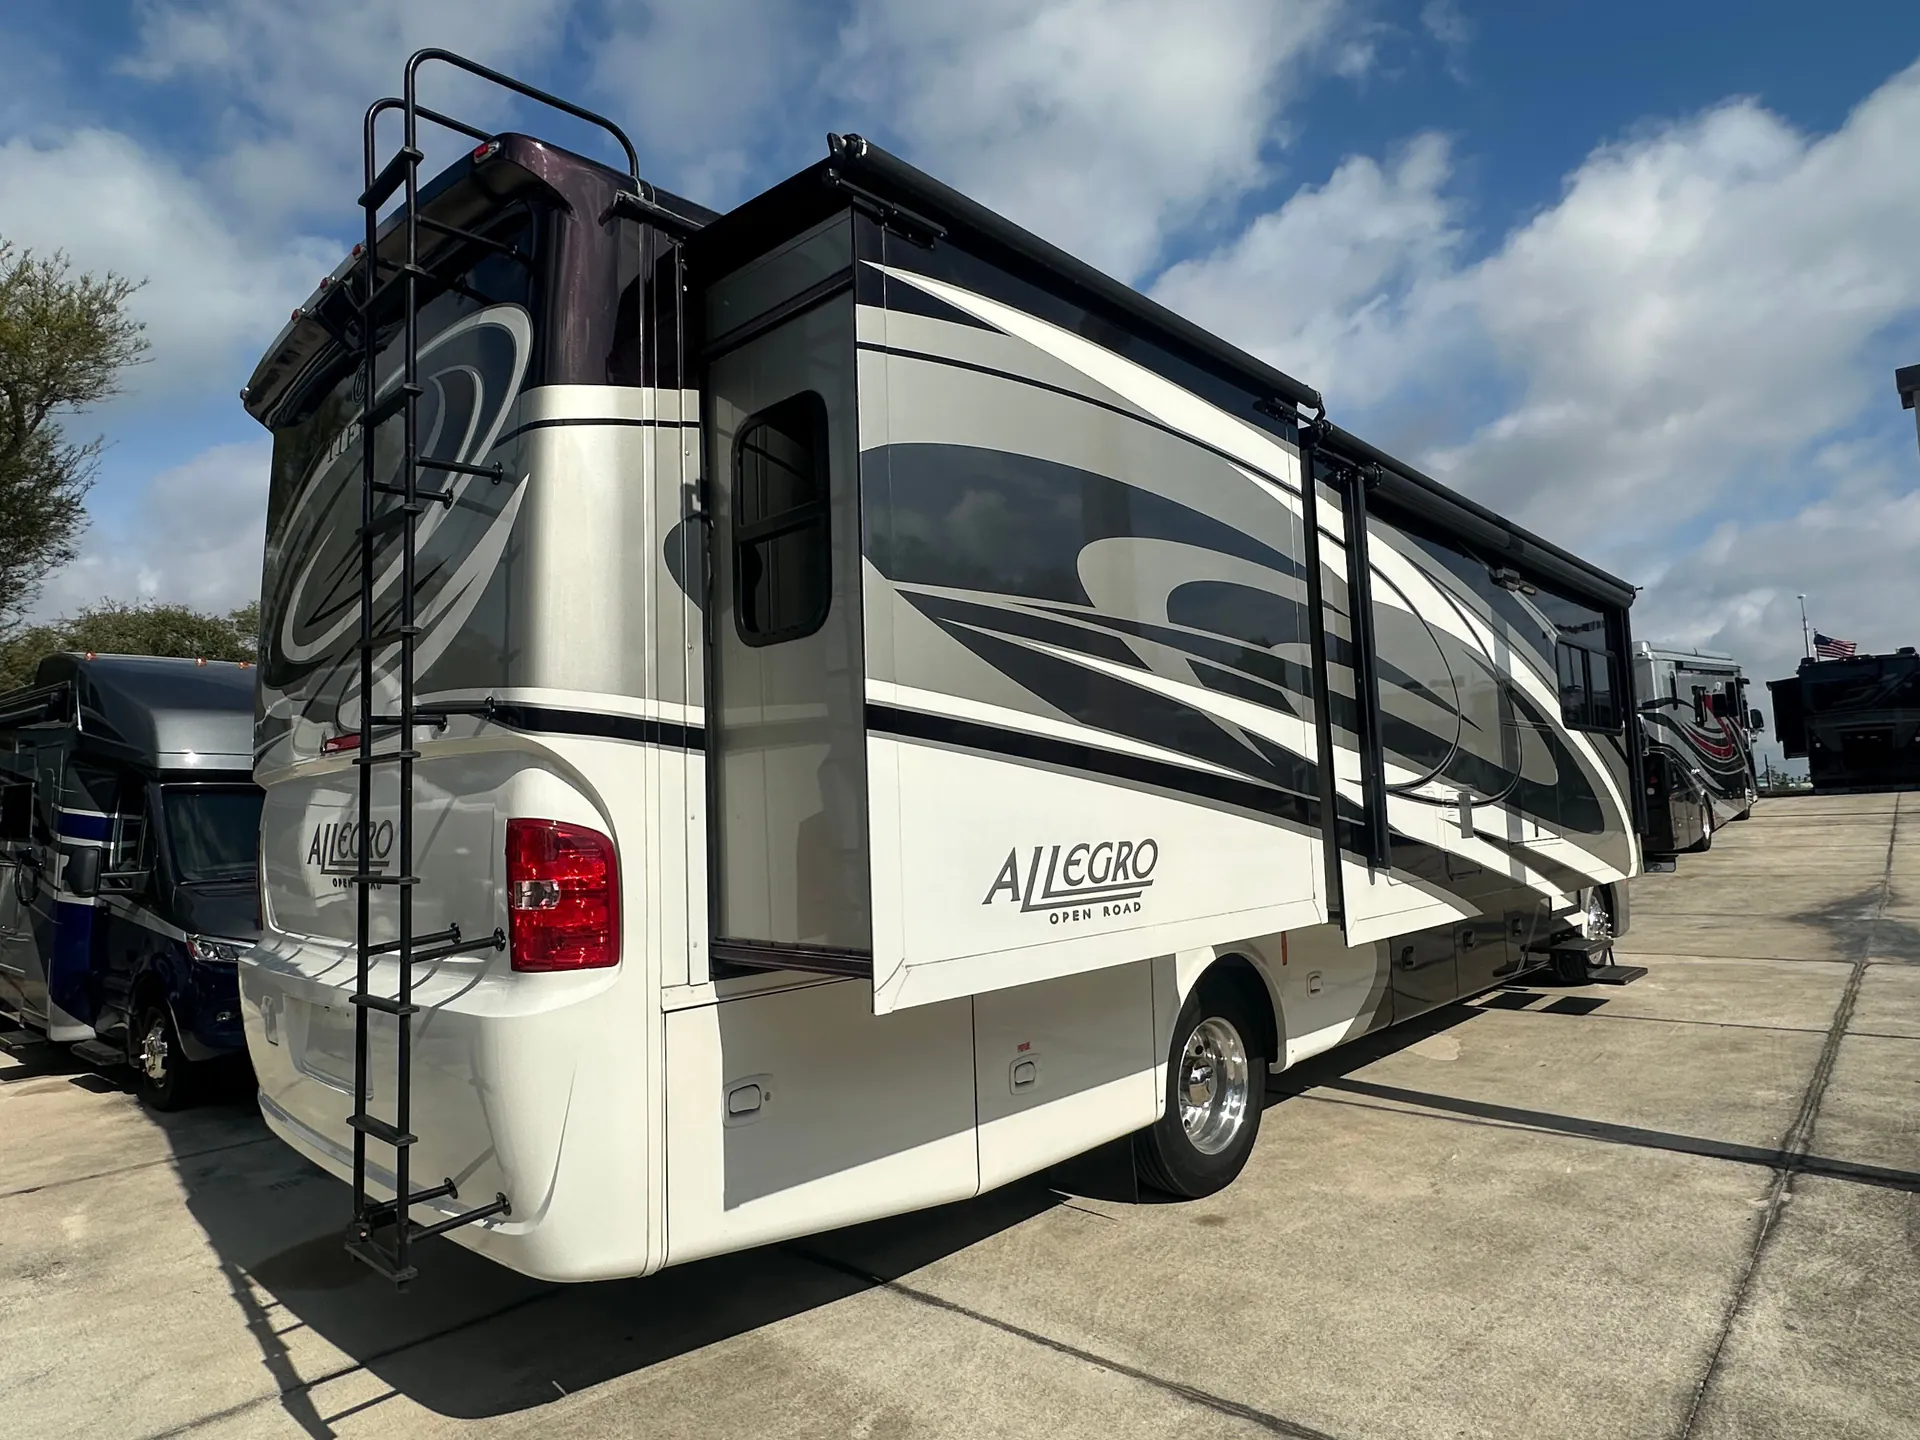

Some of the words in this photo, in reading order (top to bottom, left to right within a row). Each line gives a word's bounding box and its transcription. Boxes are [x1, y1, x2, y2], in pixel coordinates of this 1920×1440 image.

[982, 838, 1158, 913] ALLEGRO
[1049, 907, 1092, 925] OPEN
[1103, 901, 1141, 917] ROAD
